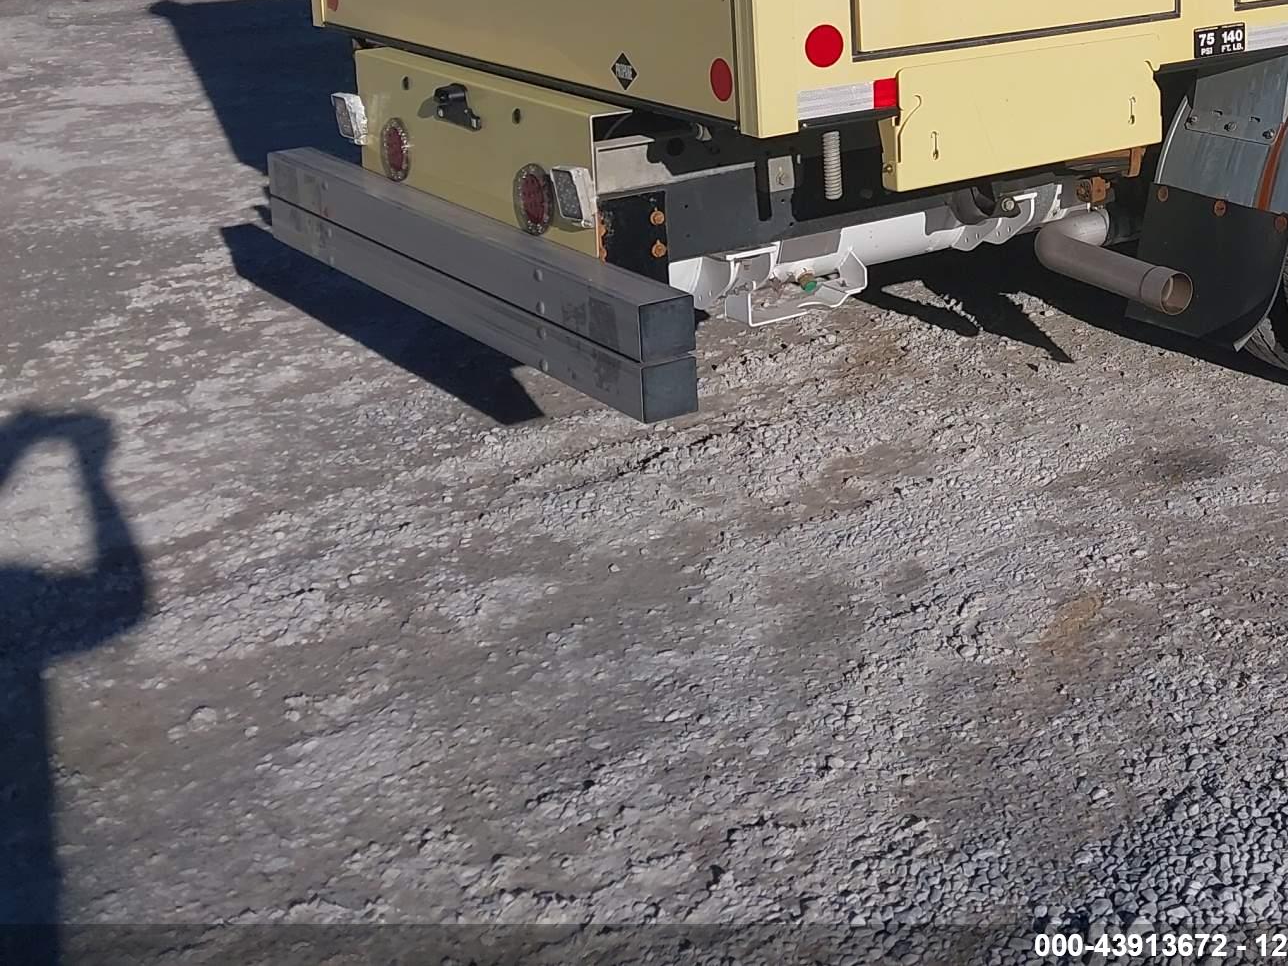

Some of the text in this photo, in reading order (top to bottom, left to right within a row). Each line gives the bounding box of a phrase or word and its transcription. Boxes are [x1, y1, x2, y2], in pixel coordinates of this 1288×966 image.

[1198, 29, 1243, 47] 75 140
[1200, 46, 1213, 56] PSI
